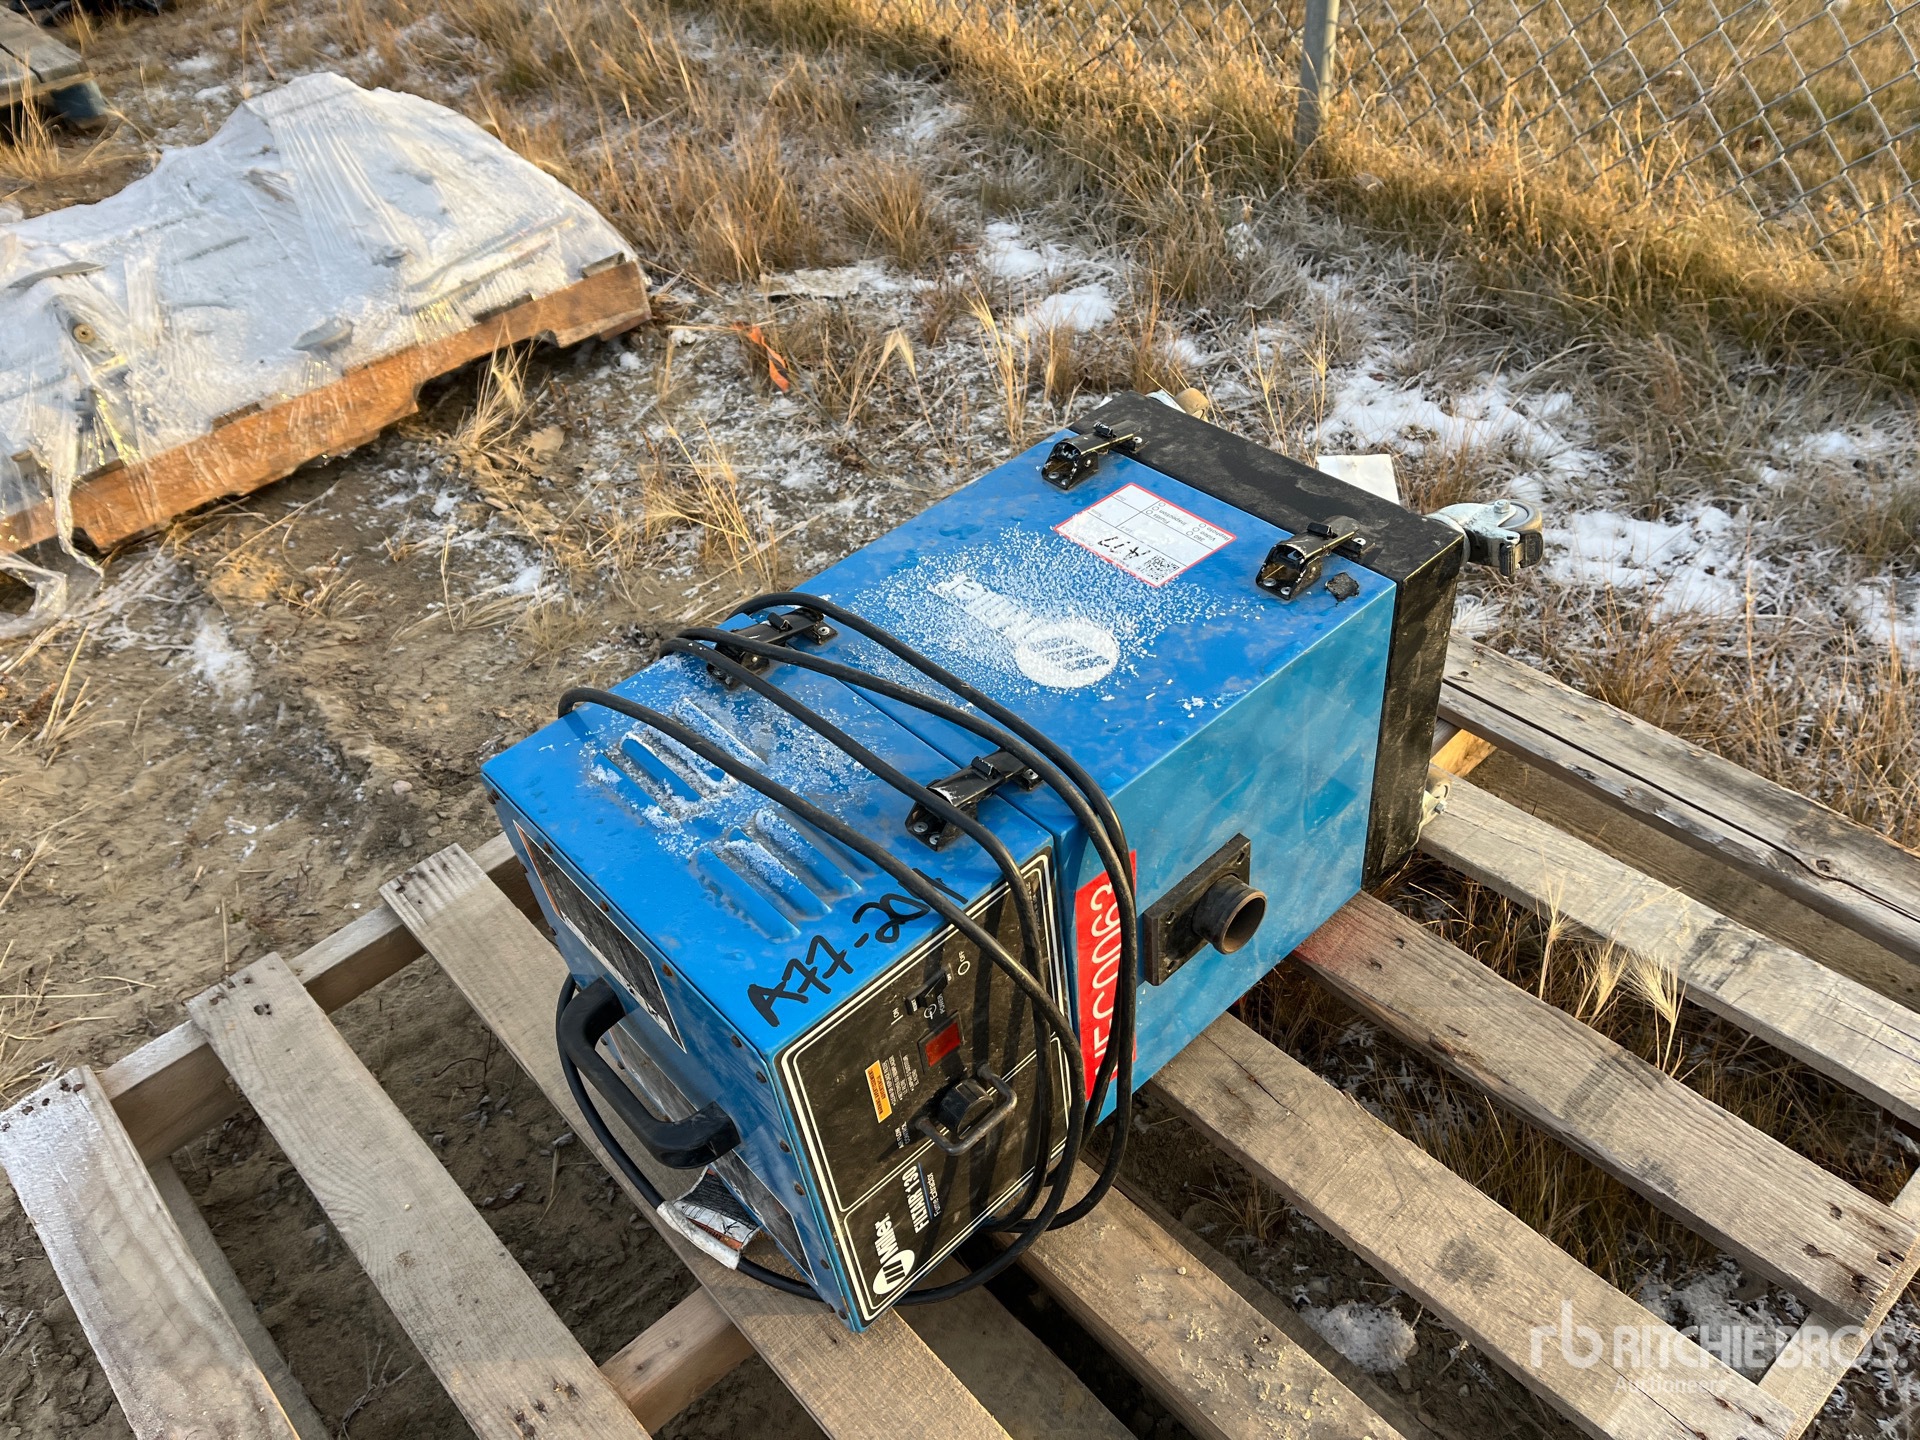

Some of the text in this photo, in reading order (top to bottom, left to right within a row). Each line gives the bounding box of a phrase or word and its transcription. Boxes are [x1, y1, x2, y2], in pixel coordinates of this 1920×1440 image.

[1151, 513, 1170, 523] Fluids
[1157, 509, 1188, 525] Inspection
[1197, 530, 1217, 541] Video
[892, 1007, 899, 1018] ON
[937, 992, 945, 1014] POWER
[901, 1164, 929, 1233] FILTAIR 130
[925, 1170, 941, 1217] Fume Extractor
[870, 1213, 898, 1264] Miller
